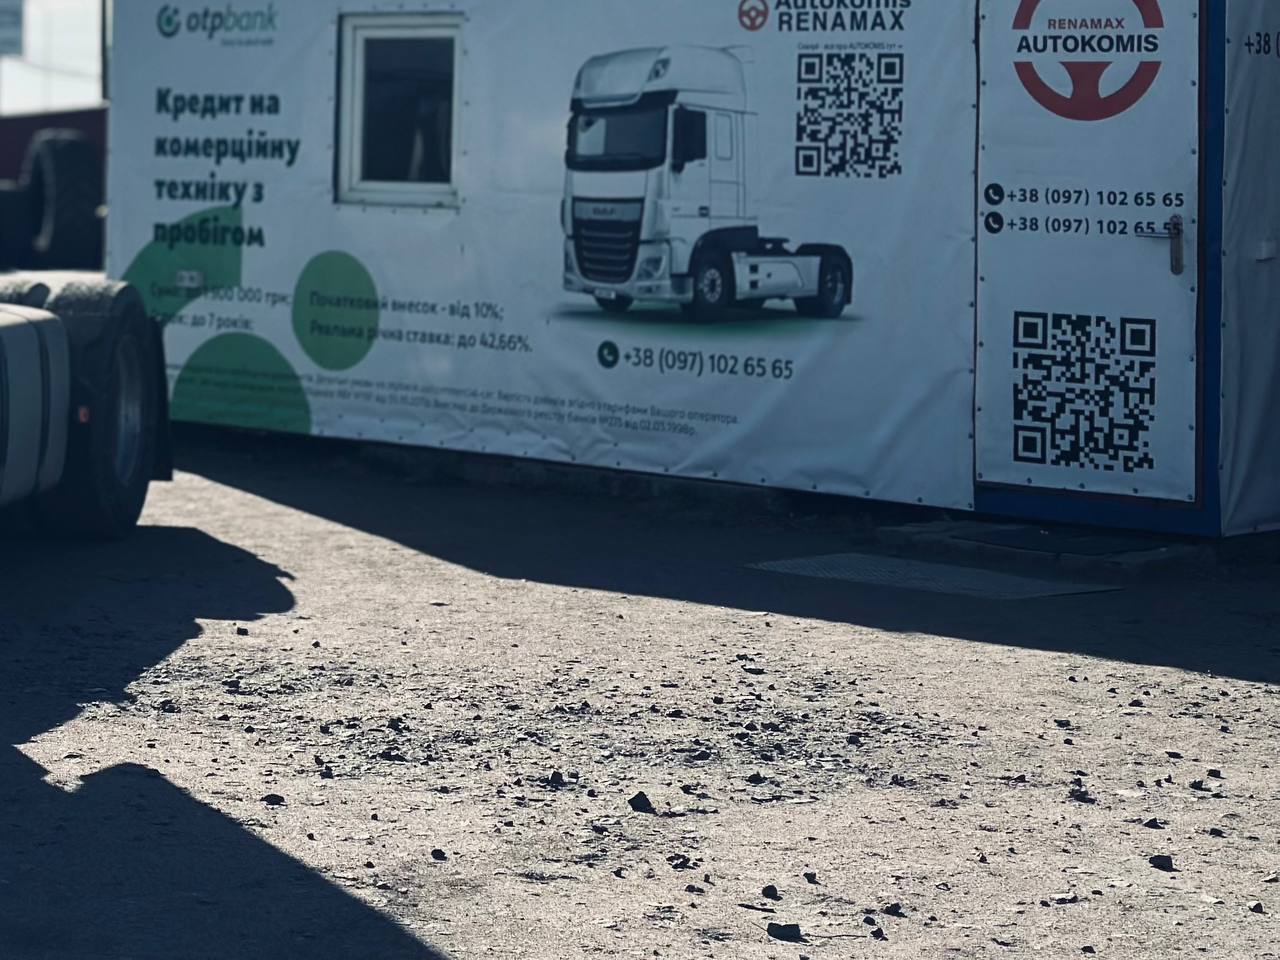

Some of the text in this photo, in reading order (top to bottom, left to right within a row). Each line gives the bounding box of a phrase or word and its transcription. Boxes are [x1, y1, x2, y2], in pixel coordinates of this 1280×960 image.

[186, 2, 278, 39] otpbank
[778, 10, 905, 32] RENAMAX
[1047, 18, 1125, 30] RENAMAX
[1017, 34, 1159, 53] AUTOKOMIS
[1244, 32, 1271, 55] +38
[156, 87, 280, 122] Кредит на
[155, 129, 300, 167] комерційну
[154, 171, 265, 210] техніку з
[1007, 188, 1184, 208] +38 (097) 102 65 65
[154, 216, 265, 249] пробігом
[1007, 217, 1039, 232] +38
[1045, 216, 1089, 235] (097)
[1096, 219, 1128, 235] 102
[391, 300, 438, 315] внесок
[449, 300, 470, 319] від
[457, 333, 477, 350] до
[624, 347, 794, 380] +38 (097) 102 65 65
